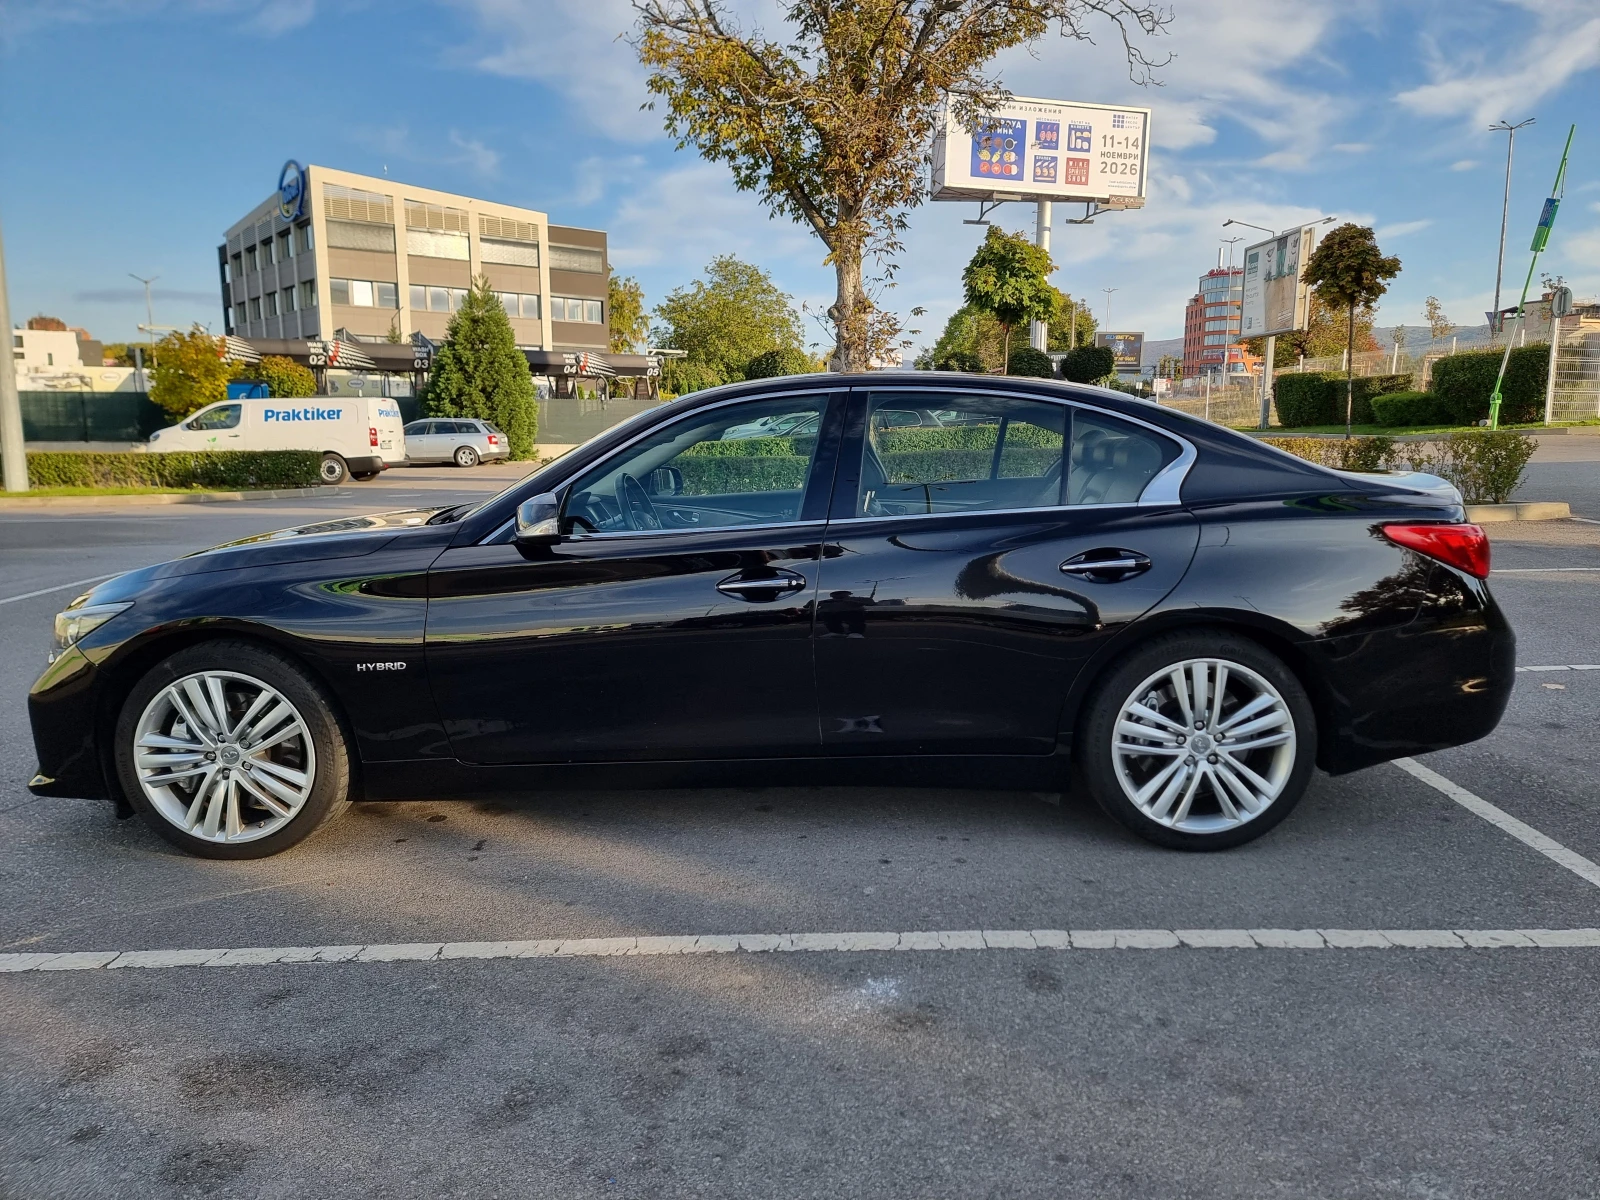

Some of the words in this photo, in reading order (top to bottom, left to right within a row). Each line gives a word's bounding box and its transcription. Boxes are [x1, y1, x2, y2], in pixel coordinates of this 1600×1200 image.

[1019, 105, 1062, 115] ИЗЛОЖЕНИЯ
[1101, 134, 1139, 150] 11-14
[1100, 150, 1139, 160] НОЕМВРИ
[1100, 161, 1138, 176] 2026
[309, 355, 326, 365] 02
[414, 359, 429, 369] 03
[563, 365, 577, 374] 04
[646, 368, 660, 376] 05
[264, 407, 343, 422] Praktiker
[356, 661, 407, 672] HYBRID
